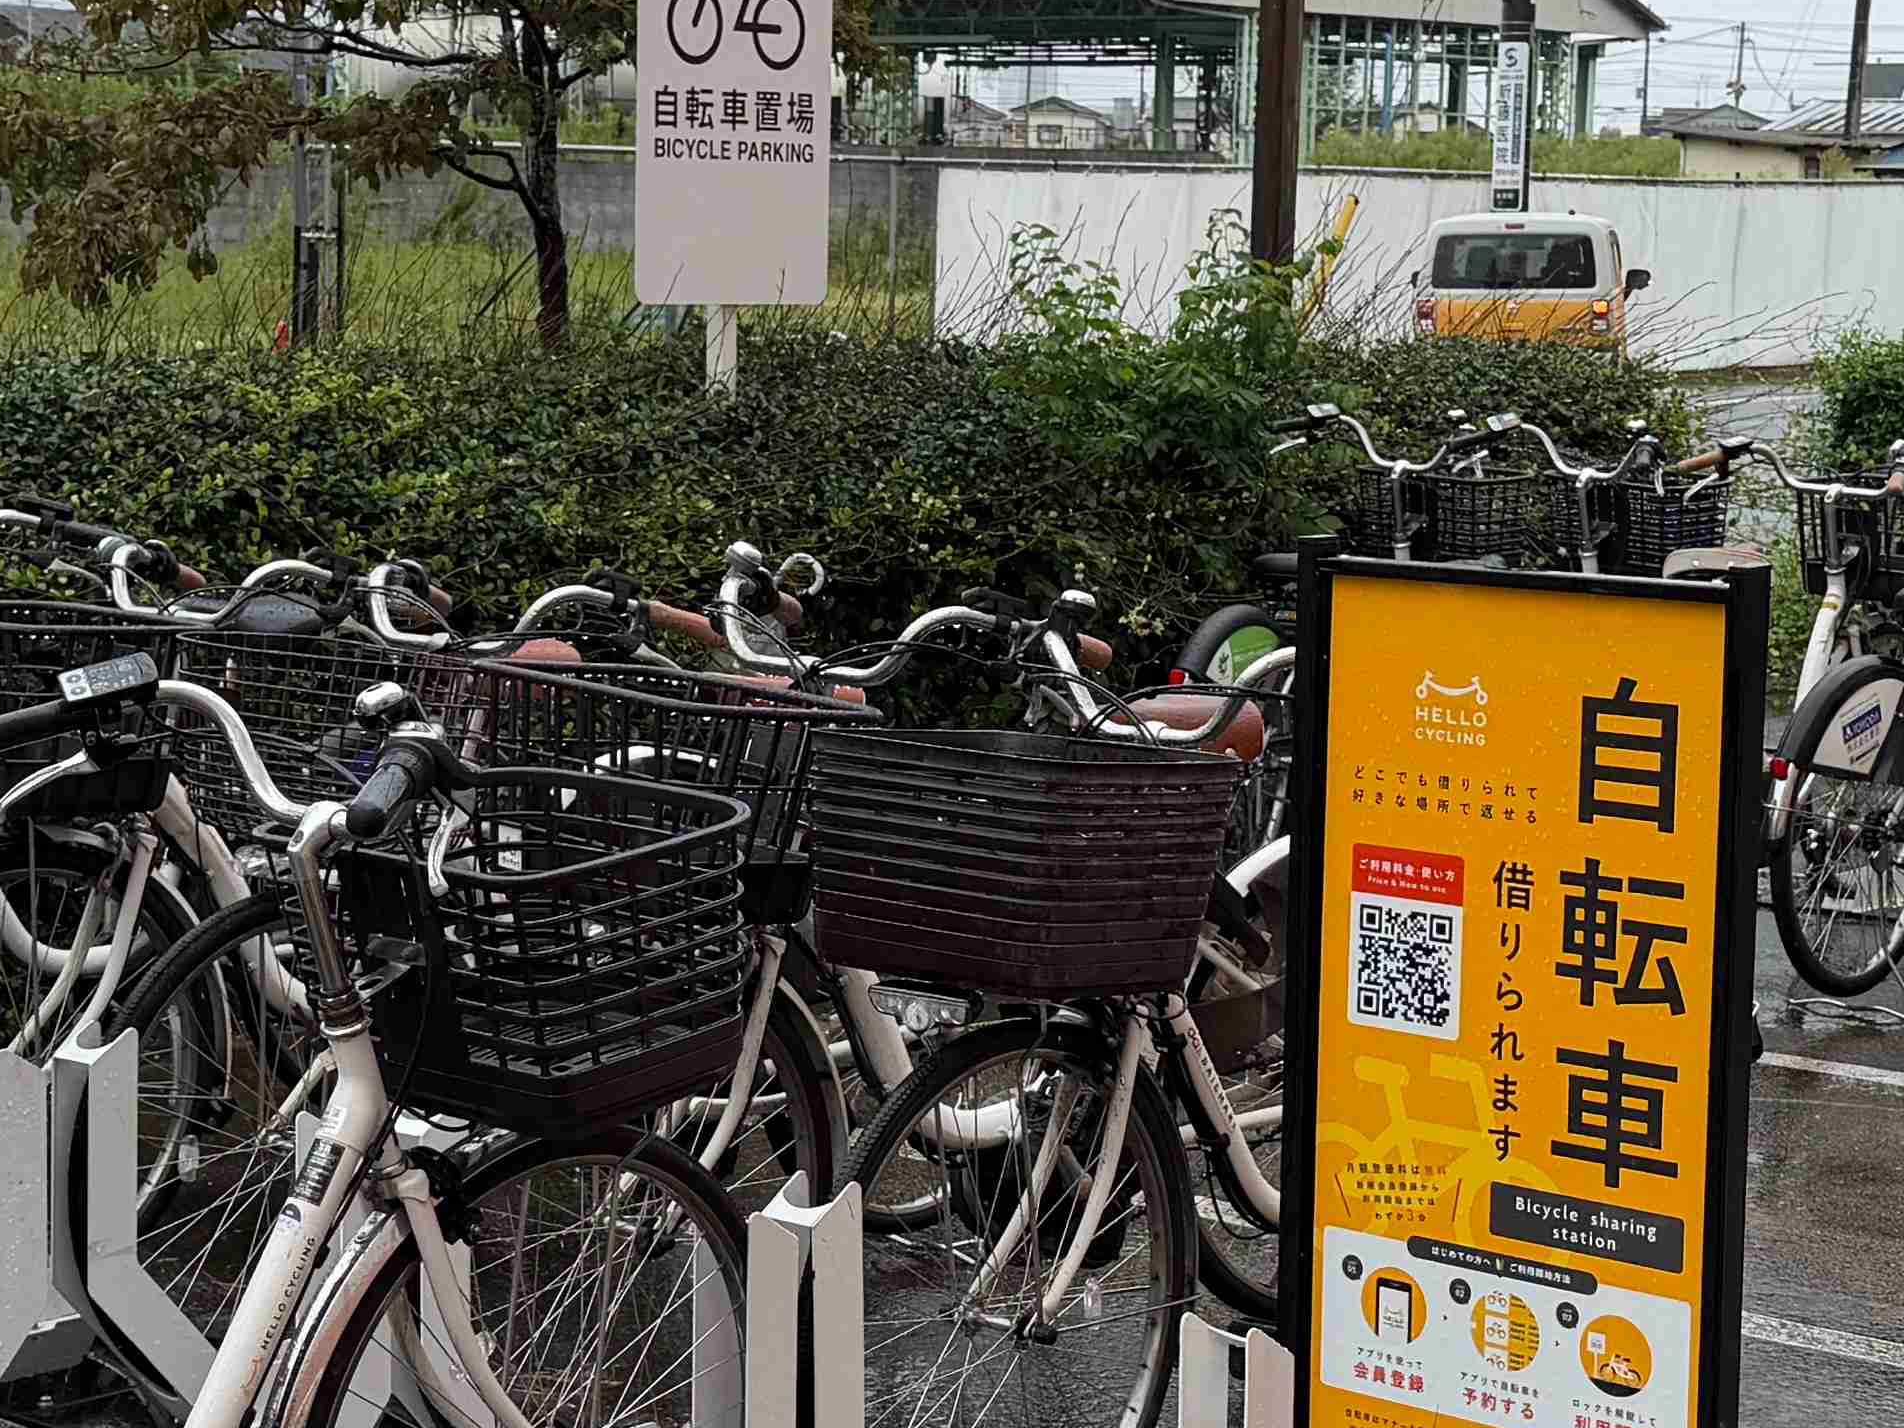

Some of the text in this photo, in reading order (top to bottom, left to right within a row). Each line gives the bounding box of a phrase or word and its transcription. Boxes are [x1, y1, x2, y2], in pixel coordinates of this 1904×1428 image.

[653, 83, 815, 135] 自転車置場
[653, 136, 815, 164] BICYCLE PARKING
[1415, 705, 1488, 728] HELLO
[1415, 727, 1486, 747] CYCLING
[1354, 764, 1538, 801] どこでも借りられて
[1352, 788, 1537, 824] 好きな場所で返せる
[1551, 677, 1689, 1189] 自転車
[1487, 860, 1535, 1161] 借りられます
[1515, 1196, 1658, 1243] Bicycle sharing
[1552, 1227, 1617, 1252] station
[260, 1236, 316, 1351] HELLO CYCLING
[1353, 1360, 1425, 1393] 会員登録
[1462, 1386, 1536, 1420] 予約する
